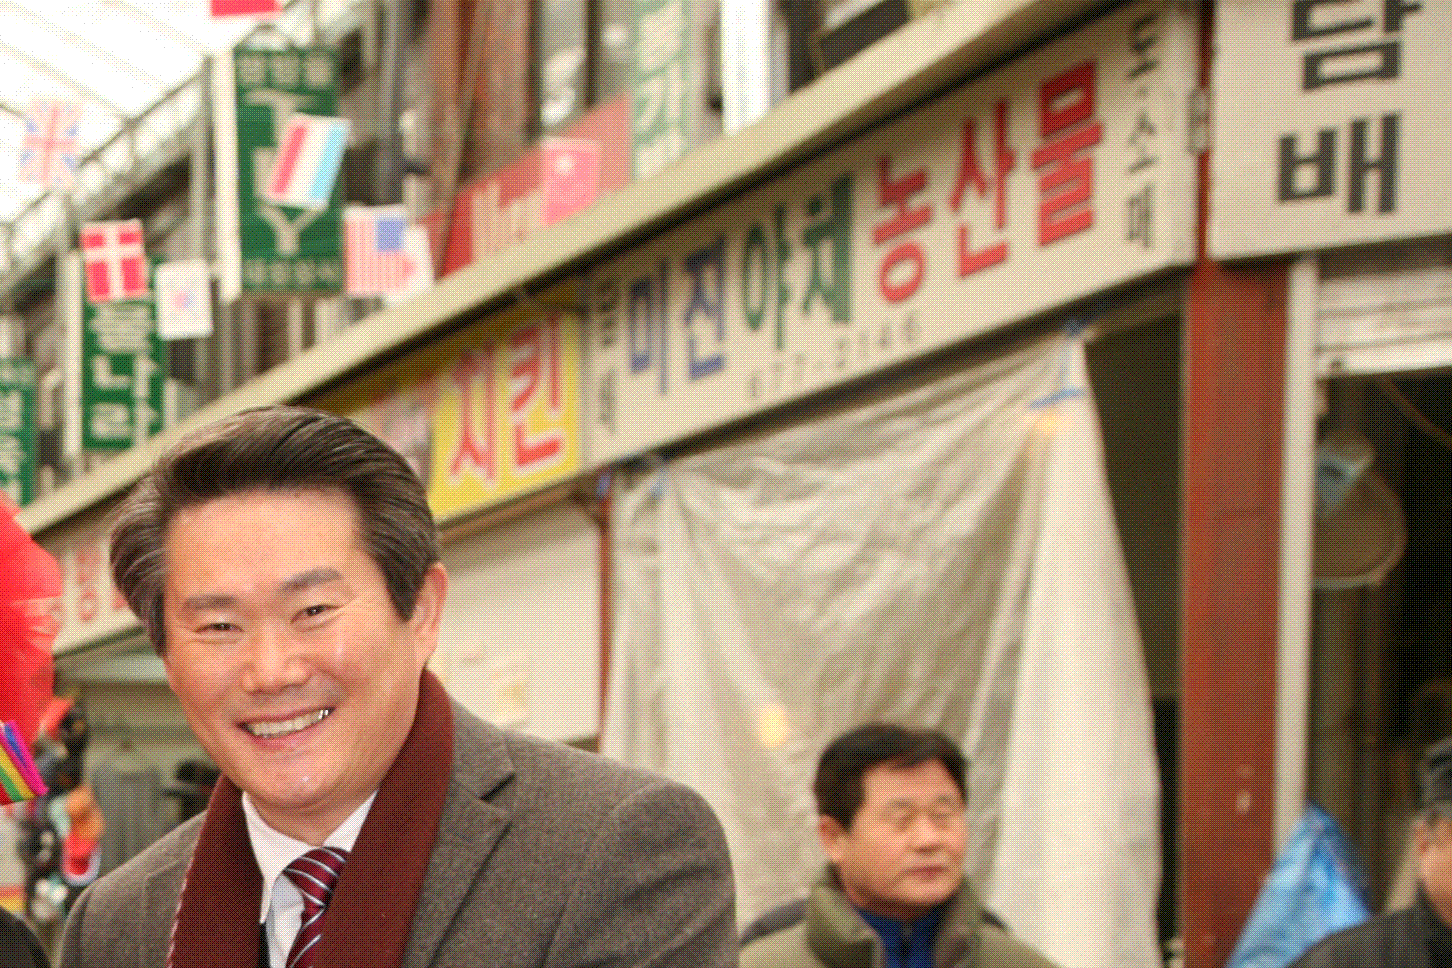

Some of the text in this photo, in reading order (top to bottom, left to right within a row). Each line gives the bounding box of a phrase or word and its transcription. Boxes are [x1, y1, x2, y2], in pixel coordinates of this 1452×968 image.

[627, 232, 728, 395] 미진
[742, 177, 852, 350] 야채
[873, 60, 1105, 305] 농산물
[1276, 0, 1423, 214] 담배
